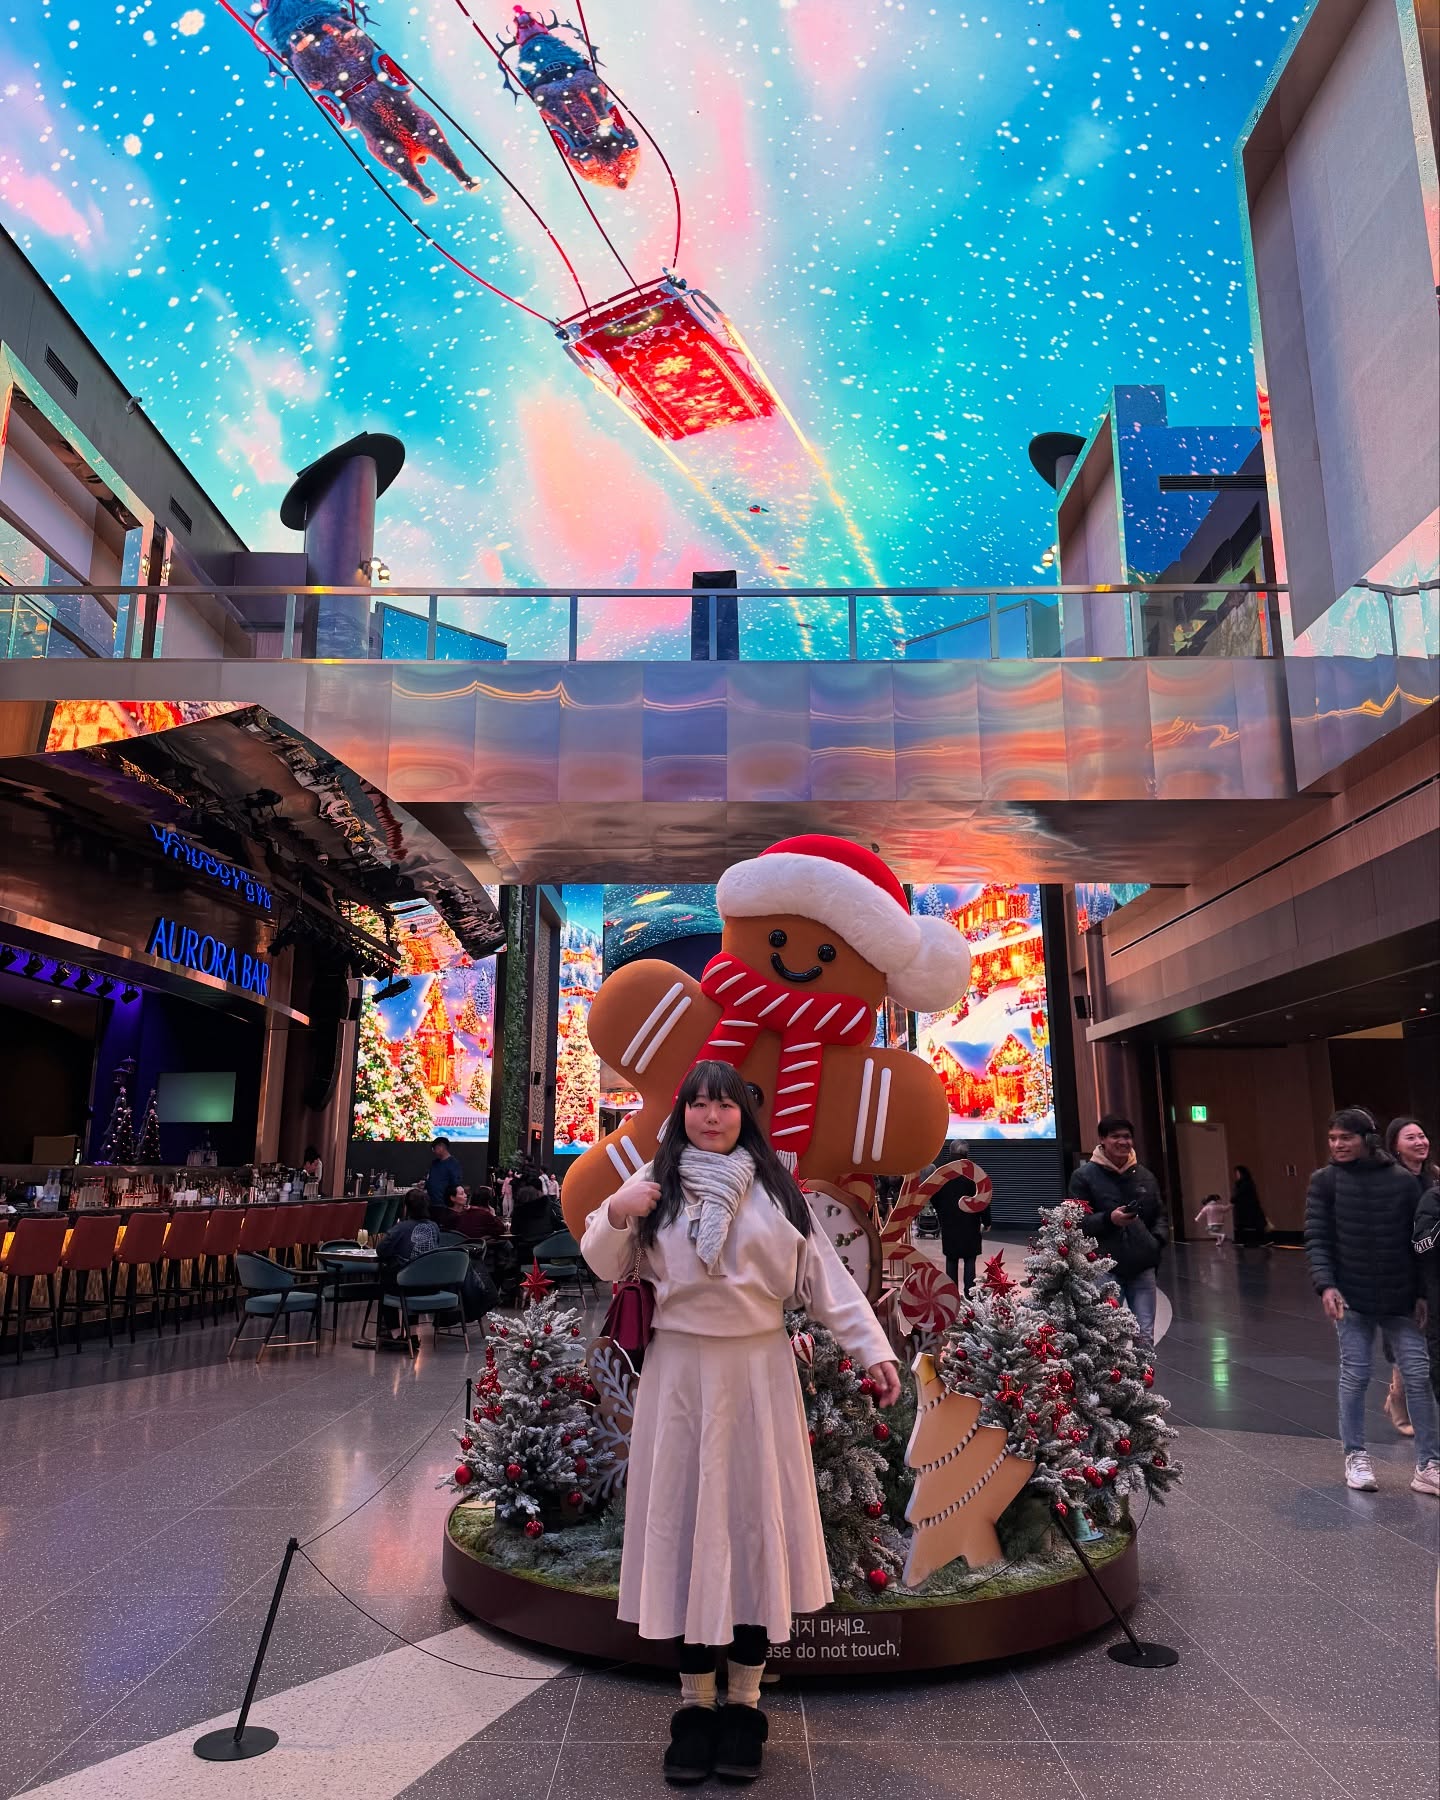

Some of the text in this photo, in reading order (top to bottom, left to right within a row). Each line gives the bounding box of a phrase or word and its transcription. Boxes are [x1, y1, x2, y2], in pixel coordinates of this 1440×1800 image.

[149, 916, 269, 997] AURORA BAR
[790, 1618, 871, 1638] 지지 마세요.
[765, 1639, 900, 1659] ase do not touch.
